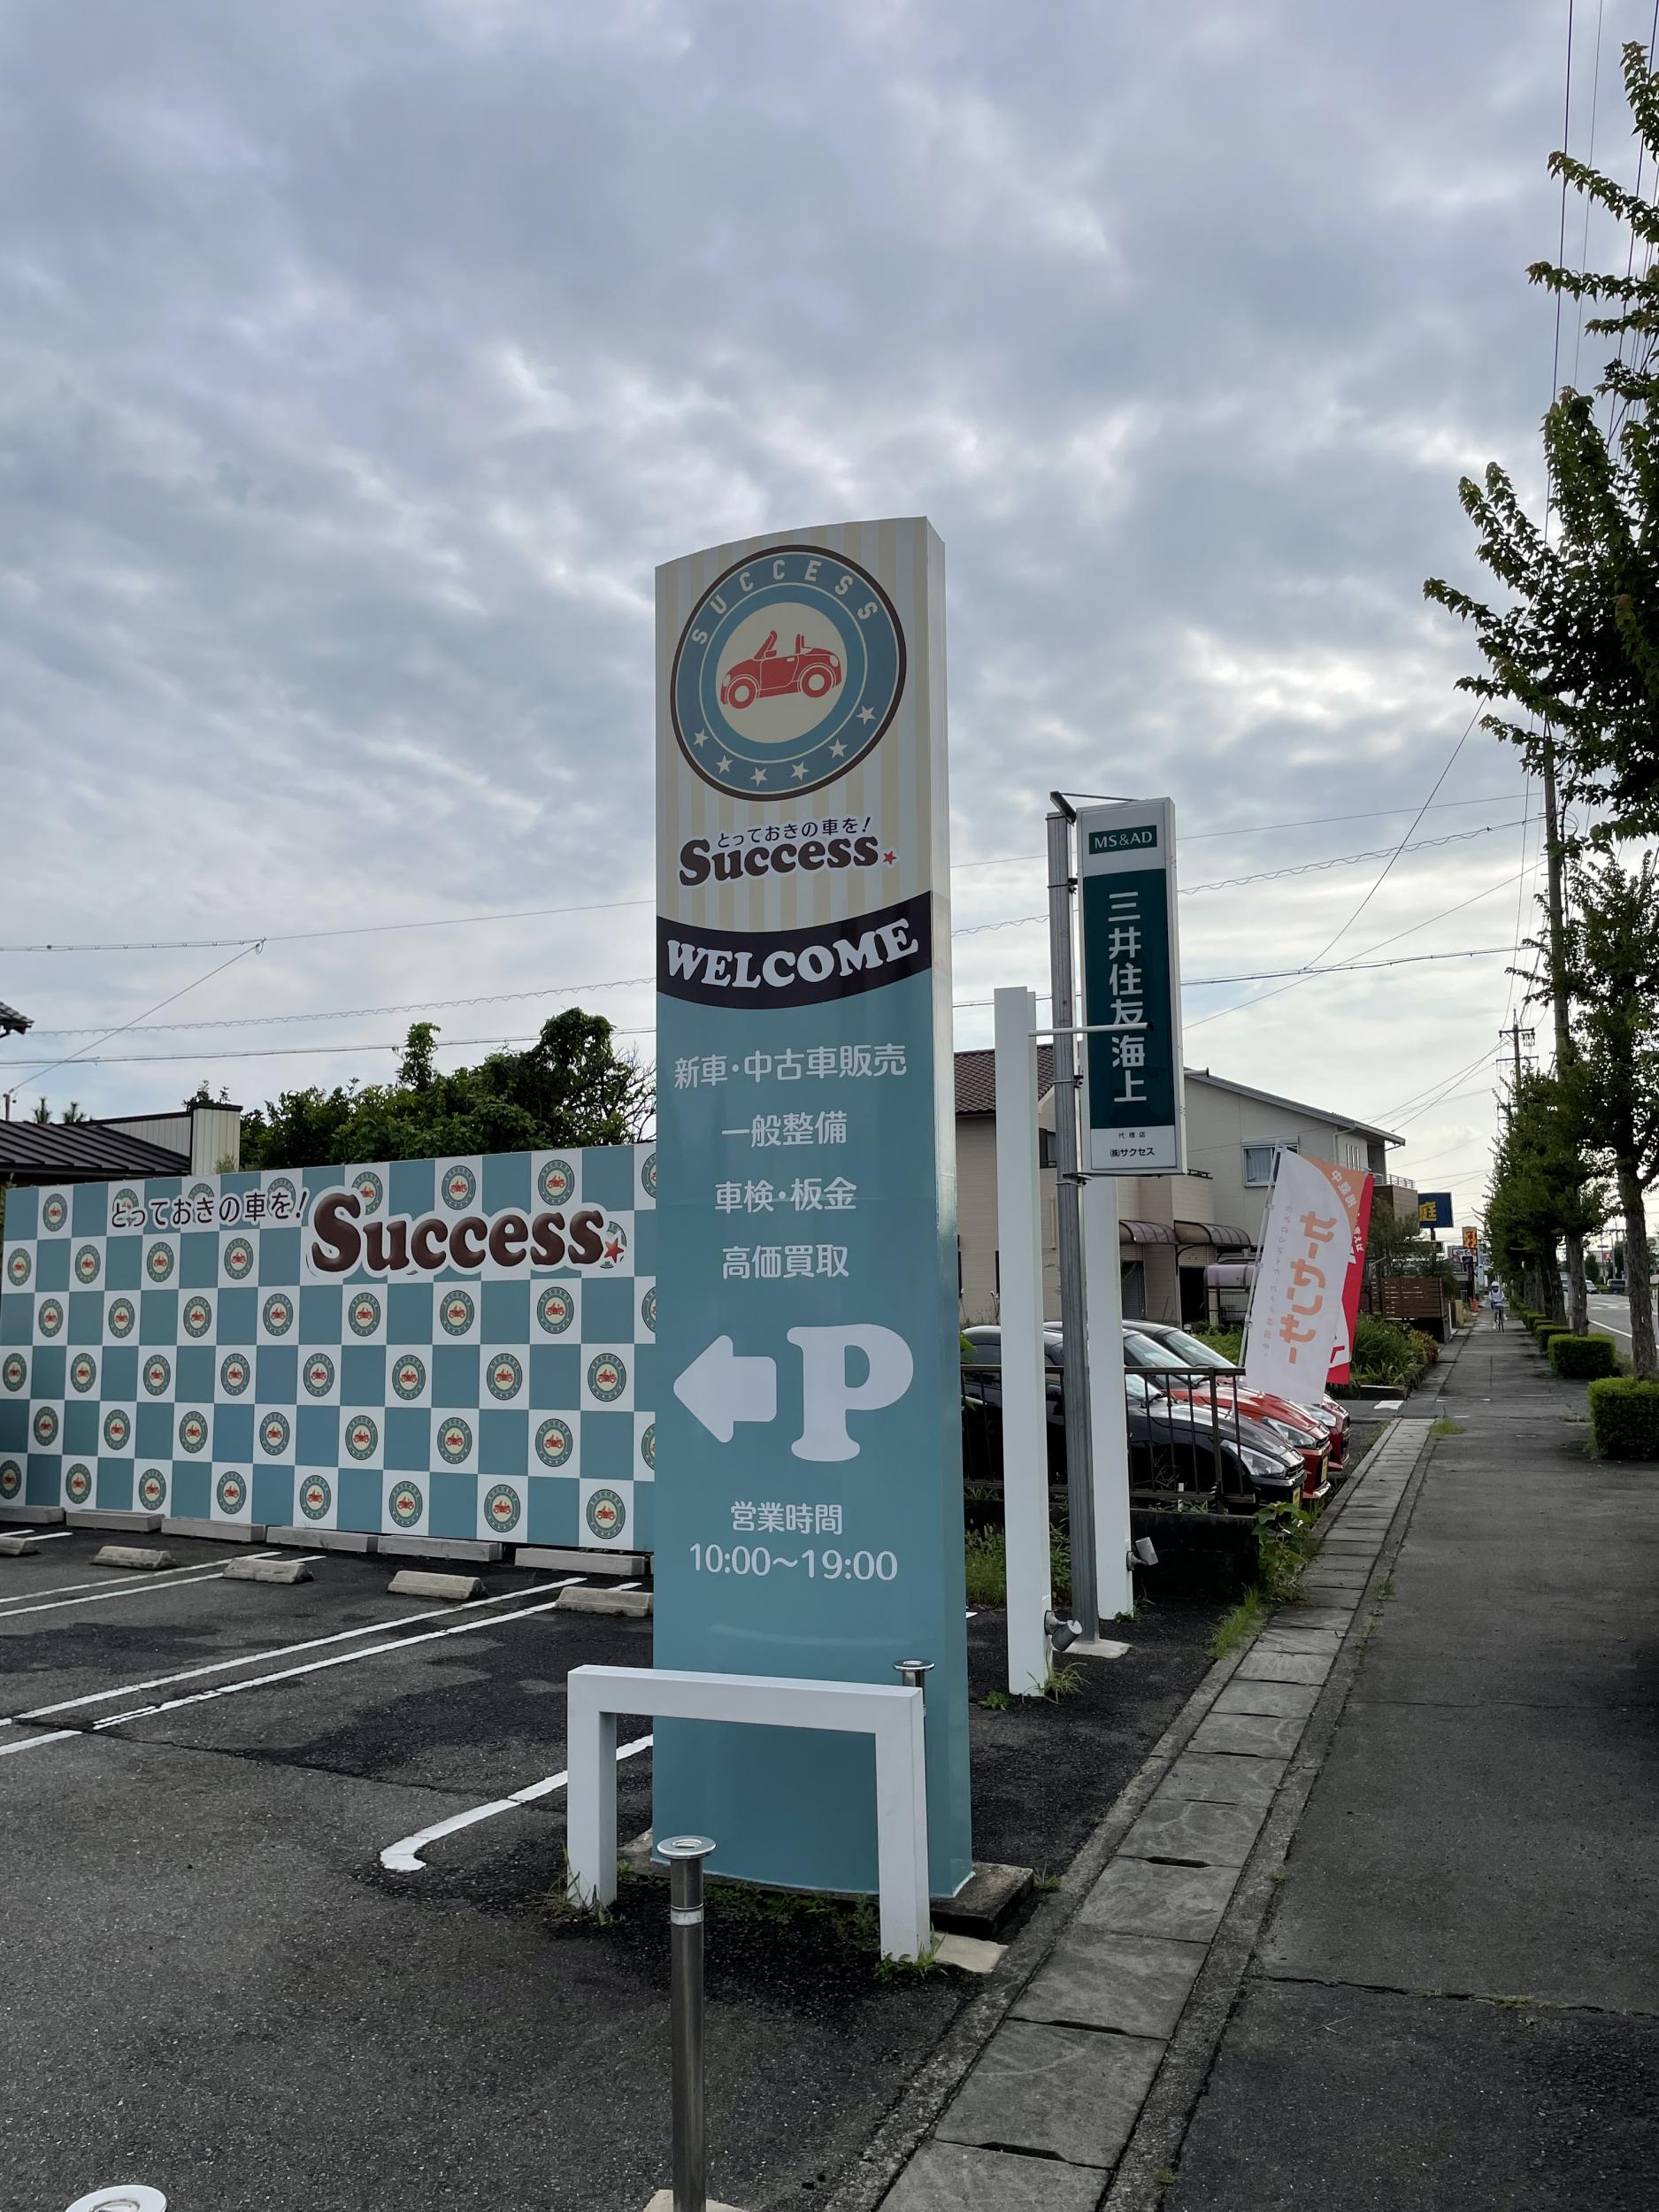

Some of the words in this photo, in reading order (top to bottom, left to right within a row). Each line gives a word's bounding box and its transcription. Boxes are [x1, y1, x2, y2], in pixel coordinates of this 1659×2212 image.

[692, 558, 879, 645] SUCCESS
[680, 835, 879, 887] Success
[1094, 830, 1152, 849] MS&AD
[666, 918, 919, 989] WELCOME
[1108, 890, 1148, 1102] 三井住友海上
[674, 1043, 906, 1089] 新車・中古車販売
[721, 1110, 848, 1148] 一般整備
[714, 1176, 857, 1214] 車検・板金
[311, 1193, 605, 1272] Success
[721, 1244, 849, 1279] 高価買取
[787, 1324, 914, 1462] P
[730, 1501, 843, 1535] 営業時間
